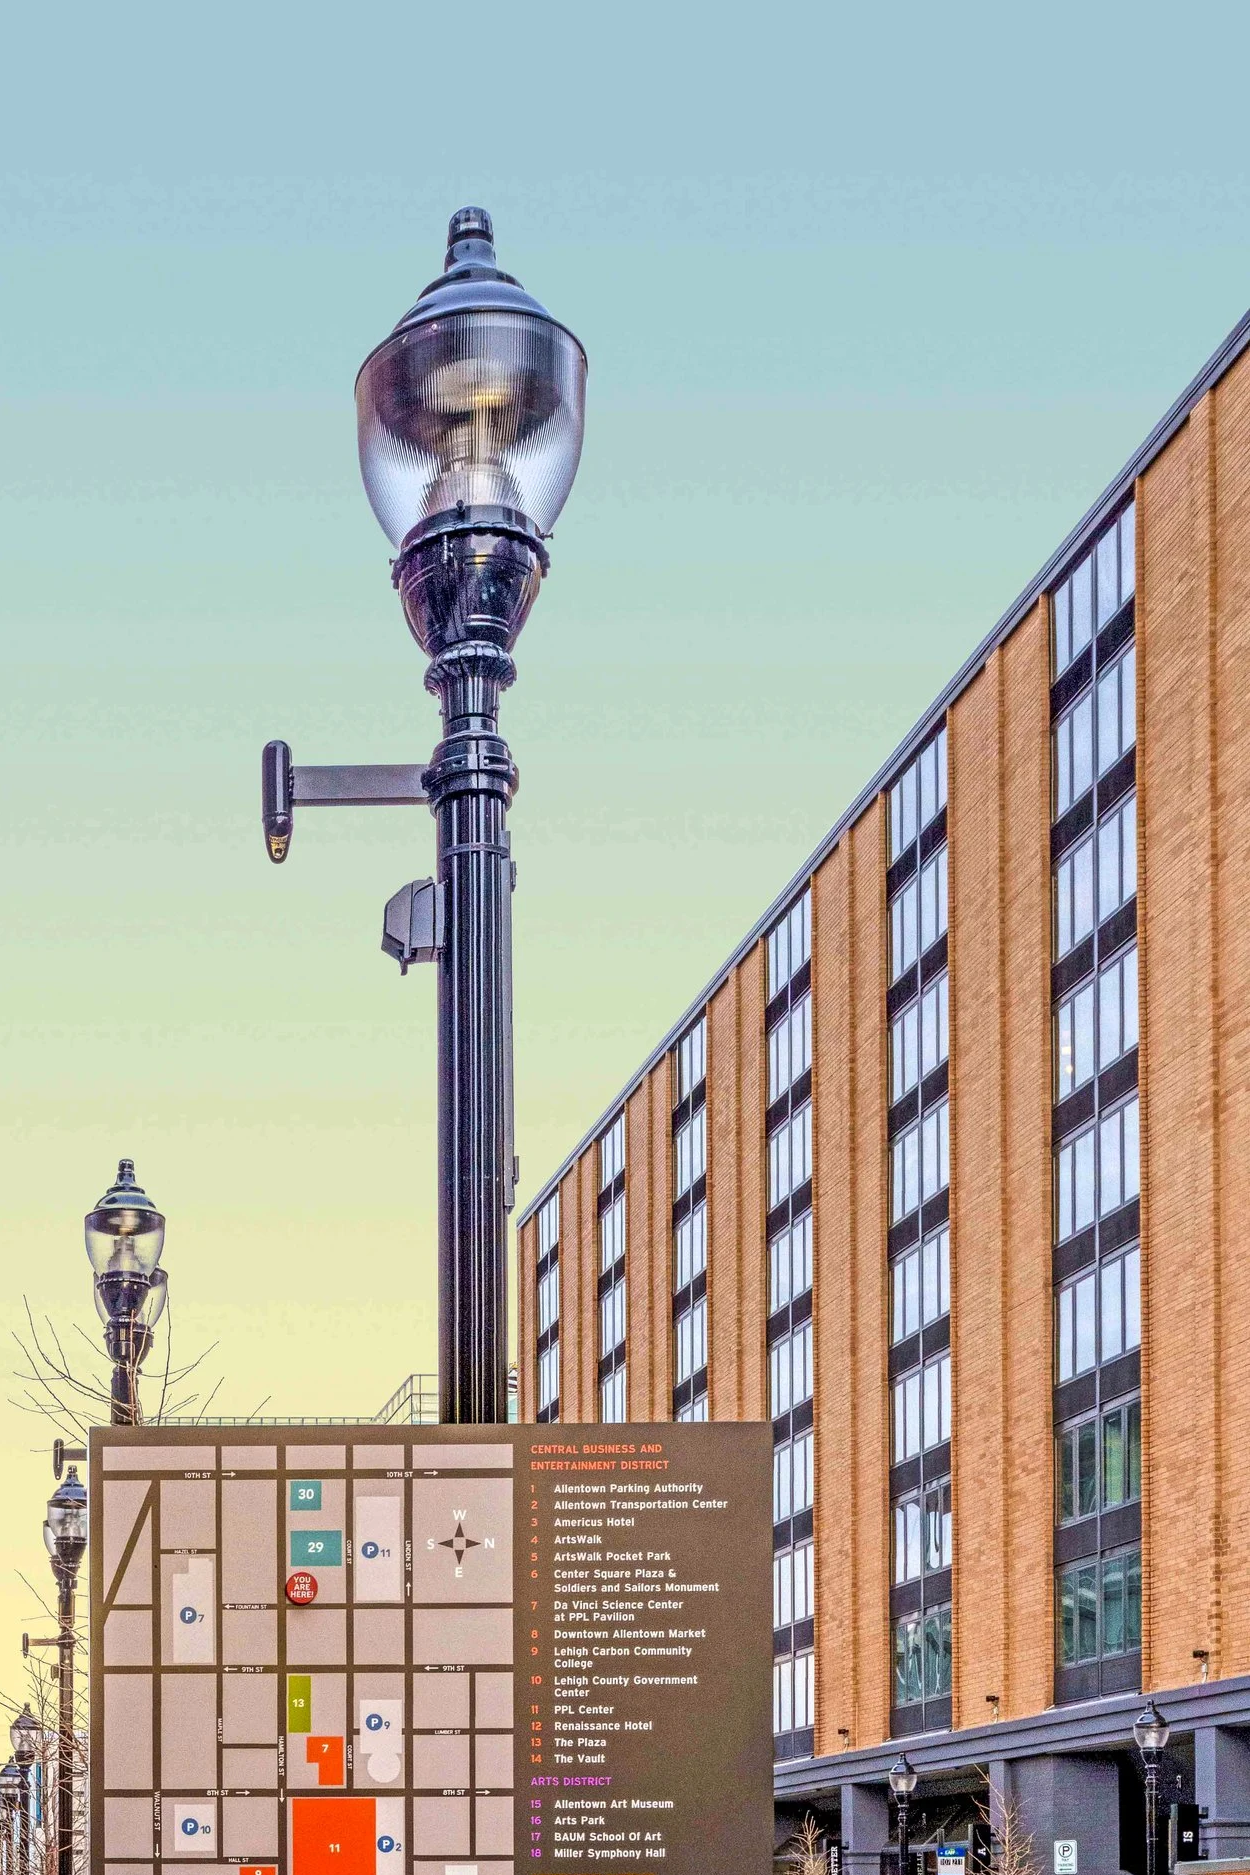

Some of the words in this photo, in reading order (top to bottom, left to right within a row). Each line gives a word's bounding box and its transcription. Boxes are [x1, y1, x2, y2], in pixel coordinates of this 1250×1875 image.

[530, 1444, 579, 1454] CENTRAL
[582, 1444, 636, 1454] BUSINESS
[640, 1443, 663, 1454] AND
[530, 1460, 617, 1471] ENTERTAINMENT
[620, 1460, 670, 1471] DISTRICT
[530, 1484, 535, 1494] 1
[553, 1483, 606, 1494] Allentown
[609, 1483, 650, 1495] Parking
[653, 1482, 704, 1495] Authority
[298, 1489, 314, 1500] 30
[530, 1499, 538, 1510] 2
[554, 1500, 606, 1510] Allentown
[609, 1499, 689, 1511] Transportation
[692, 1499, 728, 1509] Center
[453, 1510, 467, 1520] W
[308, 1542, 324, 1552] 29
[427, 1539, 435, 1549] S
[484, 1539, 495, 1549] N
[530, 1552, 539, 1562] 5
[553, 1551, 602, 1562] ArtsWalk
[606, 1551, 644, 1561] Pocket
[646, 1551, 671, 1561] Park
[455, 1567, 463, 1577] E
[530, 1600, 538, 1611] 7
[554, 1600, 568, 1610] Da
[572, 1600, 598, 1610] Vinci
[602, 1599, 644, 1610] Science
[647, 1599, 684, 1610] Center
[554, 1612, 566, 1622] at
[569, 1612, 590, 1622] PPL
[593, 1611, 635, 1622] Pavilion
[530, 1646, 539, 1656] 9
[554, 1646, 589, 1658] Lehigh
[592, 1646, 630, 1656] Carbon
[633, 1645, 693, 1658] Community
[554, 1658, 593, 1670] College
[530, 1675, 543, 1685] 10
[554, 1675, 589, 1687] Lehigh
[592, 1675, 630, 1687] County
[633, 1675, 698, 1685] Government
[554, 1687, 590, 1698] Center
[530, 1776, 560, 1787] ARTS
[563, 1776, 612, 1787] DISTRICT
[530, 1799, 542, 1809] 15
[554, 1799, 607, 1809] Allentown
[610, 1799, 628, 1809] Art
[631, 1799, 674, 1809] Museum
[1183, 1831, 1193, 1843] IS
[329, 1844, 340, 1853] 11
